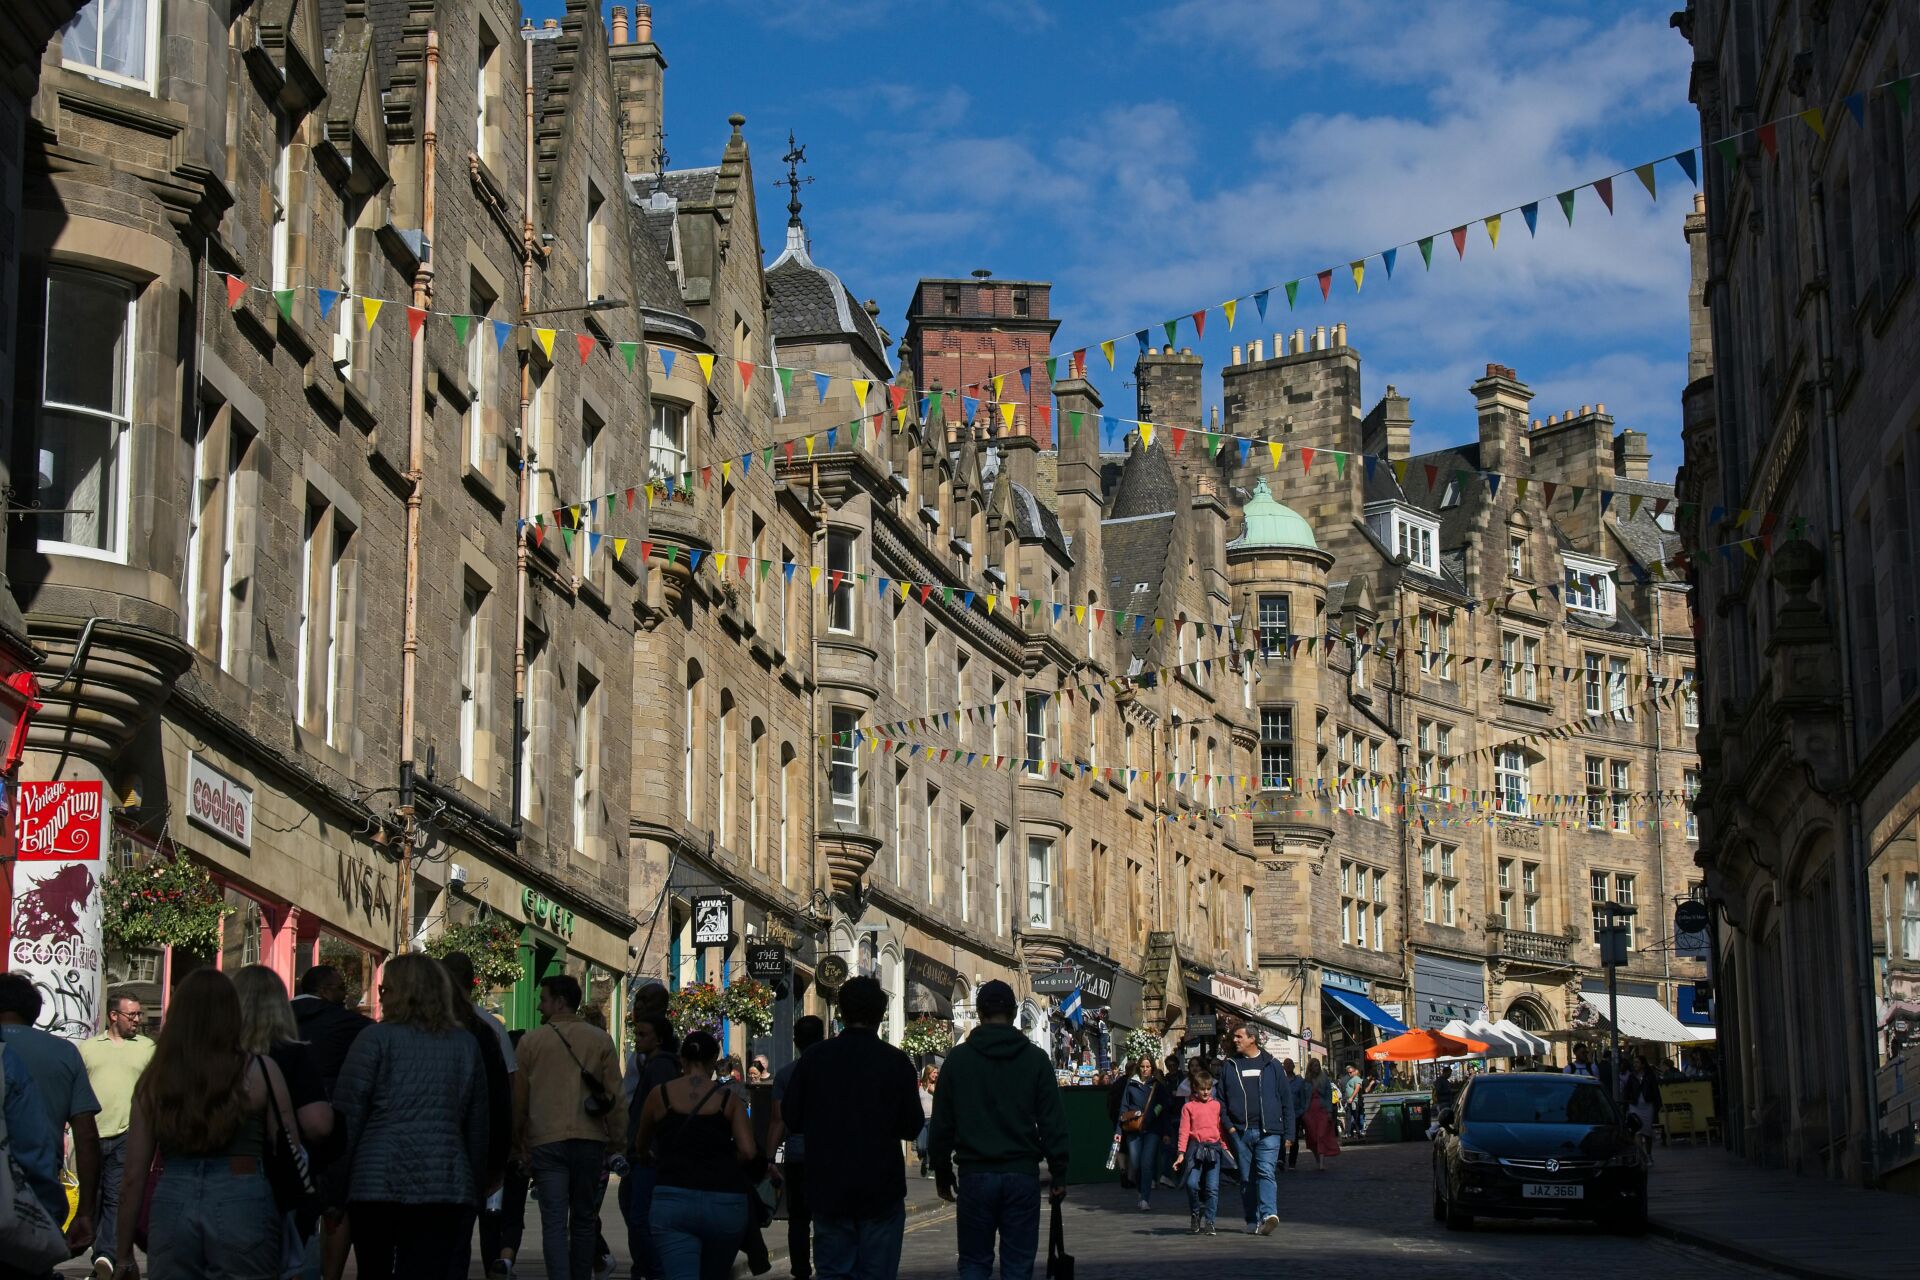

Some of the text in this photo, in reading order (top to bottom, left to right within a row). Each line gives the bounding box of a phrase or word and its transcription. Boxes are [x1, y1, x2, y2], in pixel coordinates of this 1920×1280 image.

[23, 782, 66, 816] Vintage
[192, 777, 245, 839] cookie
[20, 788, 99, 855] Emporium
[337, 850, 386, 922] MYSA
[699, 899, 723, 907] VIVA
[13, 937, 97, 972] cookie
[696, 934, 728, 943] MEXICO
[756, 949, 779, 960] THE
[754, 961, 781, 971] WALL
[1074, 967, 1110, 999] COLAND
[1529, 1185, 1577, 1196] JAZ 3661
